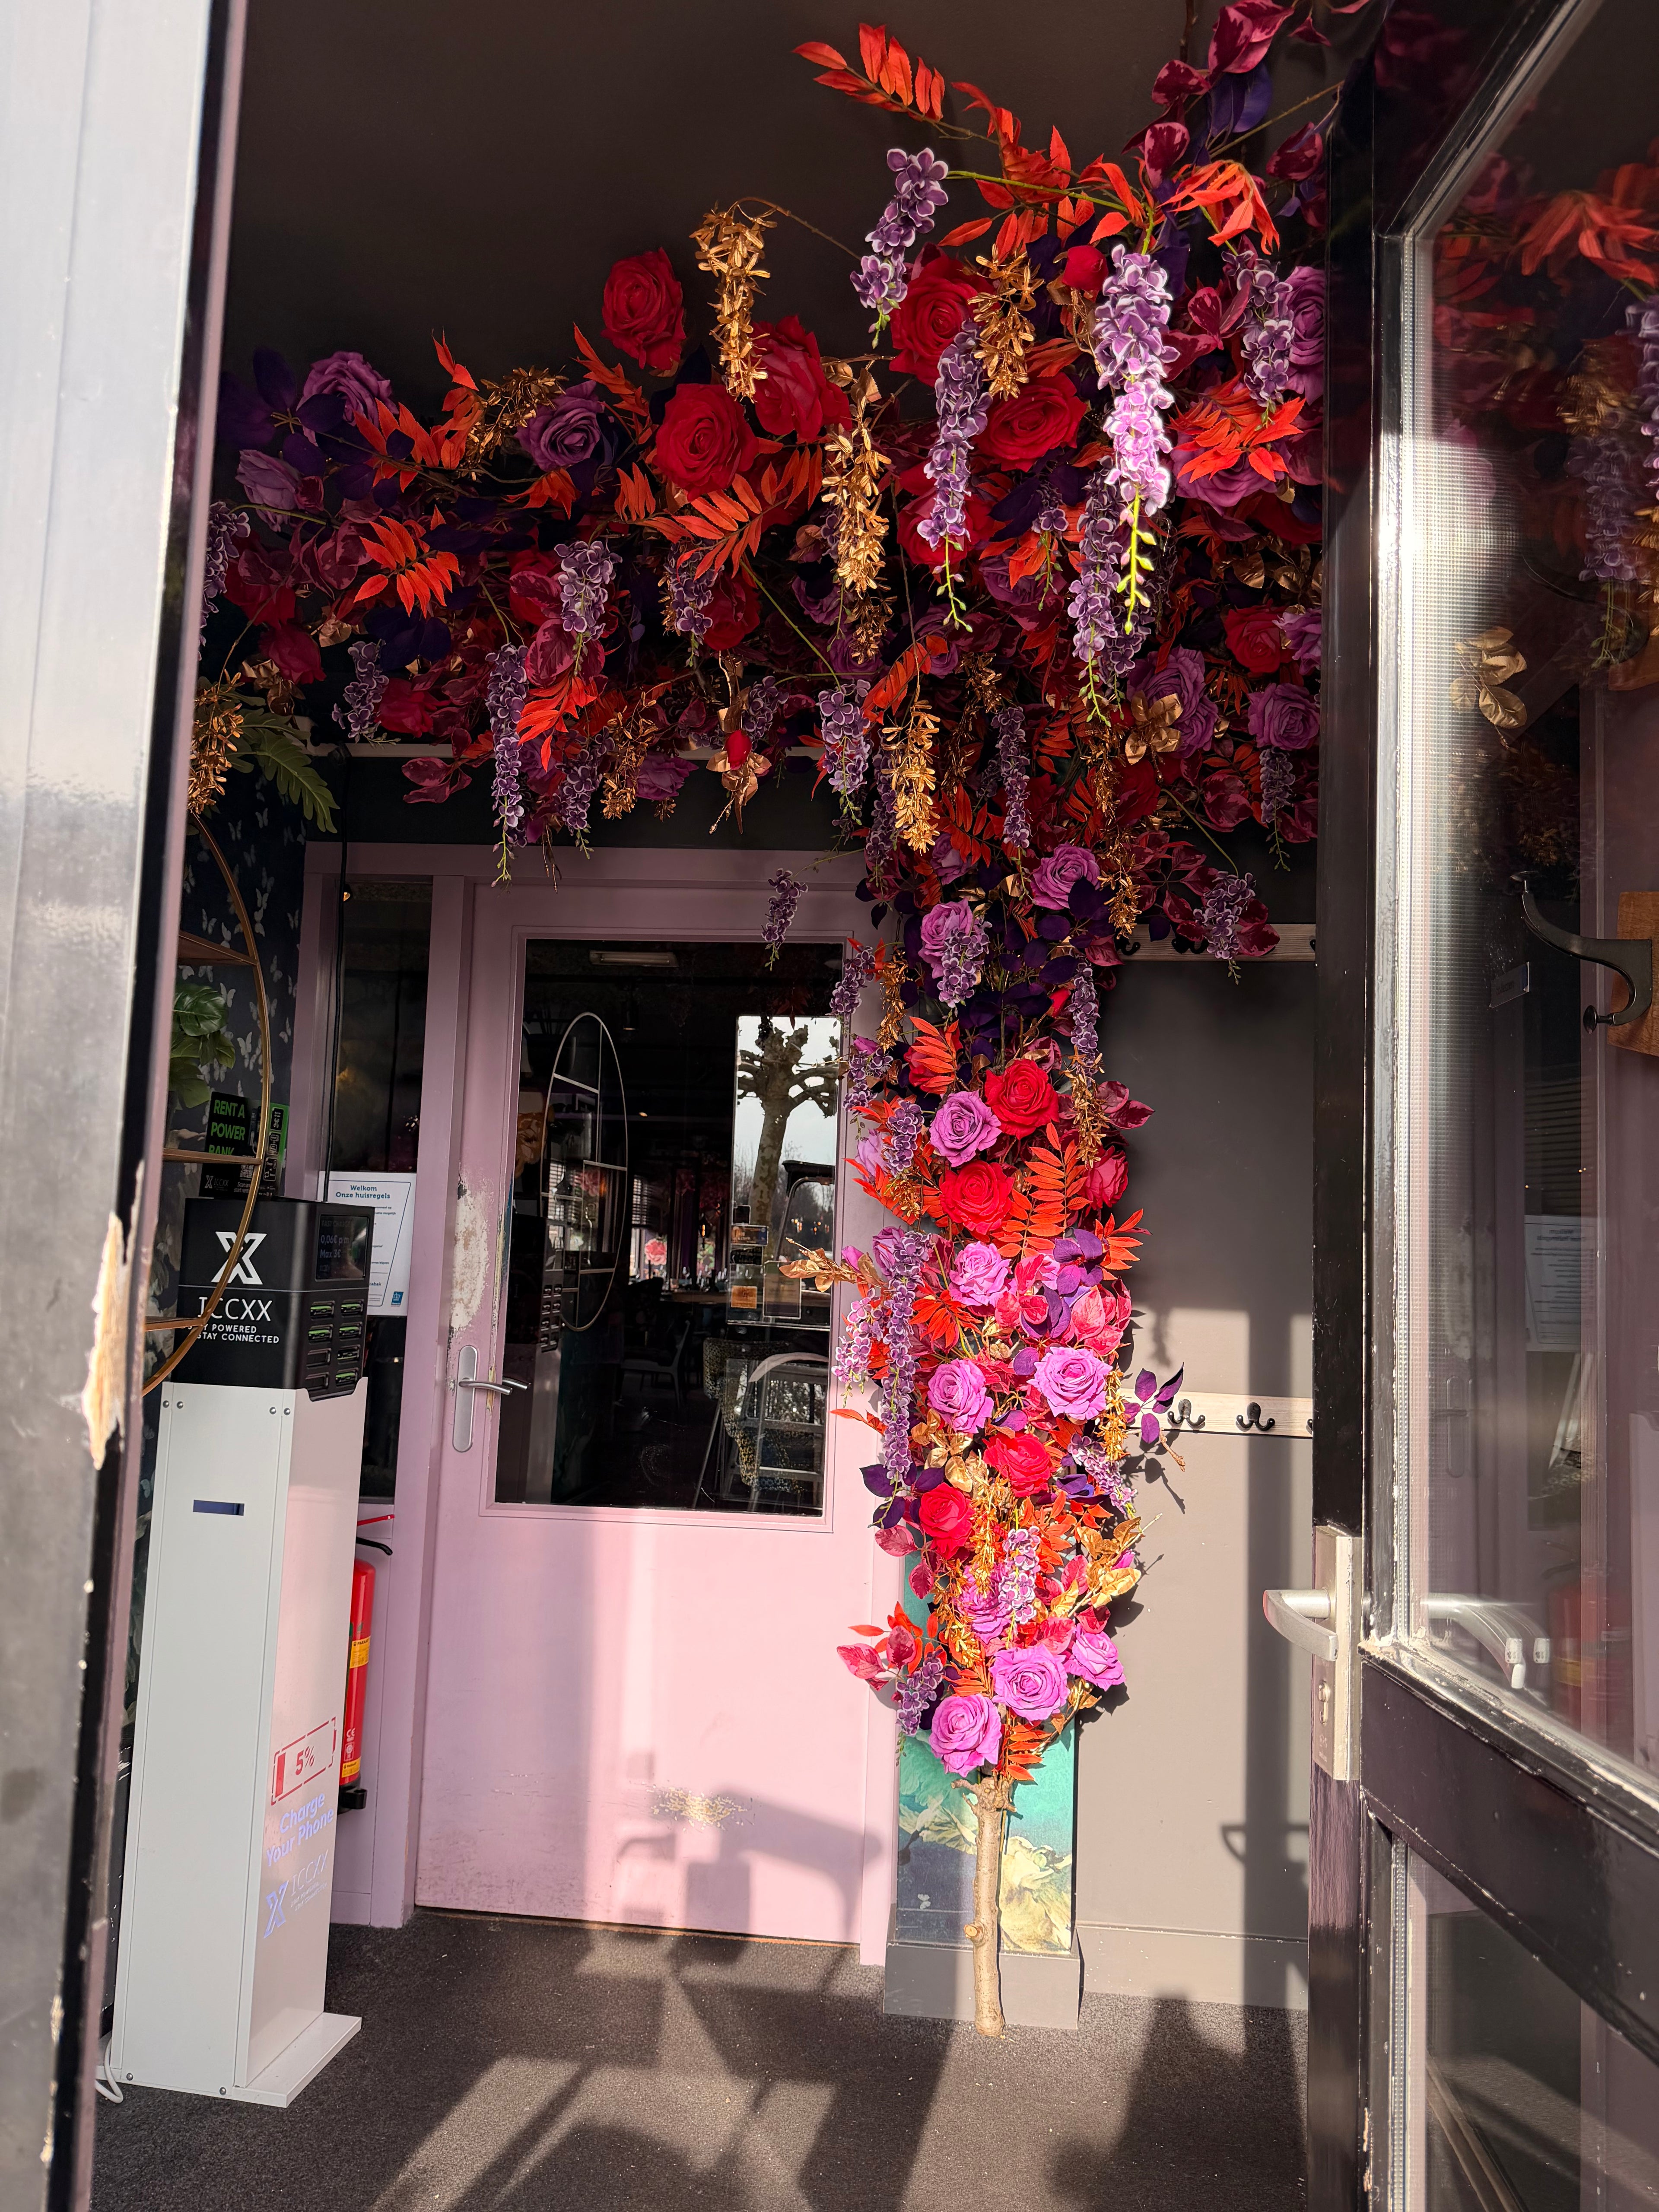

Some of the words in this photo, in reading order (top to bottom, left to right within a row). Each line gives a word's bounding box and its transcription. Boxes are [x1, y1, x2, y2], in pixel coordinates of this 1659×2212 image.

[213, 1100, 238, 1116] RENT
[238, 1104, 245, 1118] A
[210, 1122, 246, 1141] POWER
[321, 1235, 338, 1245] 0,06€
[320, 1249, 332, 1258] Max
[212, 1324, 257, 1333] POWERED
[222, 1333, 279, 1344] CONNECTED
[296, 1746, 315, 1775] 5%
[280, 1793, 325, 1834] Charge
[267, 1836, 295, 1867] Your
[297, 1808, 334, 1846] Phone
